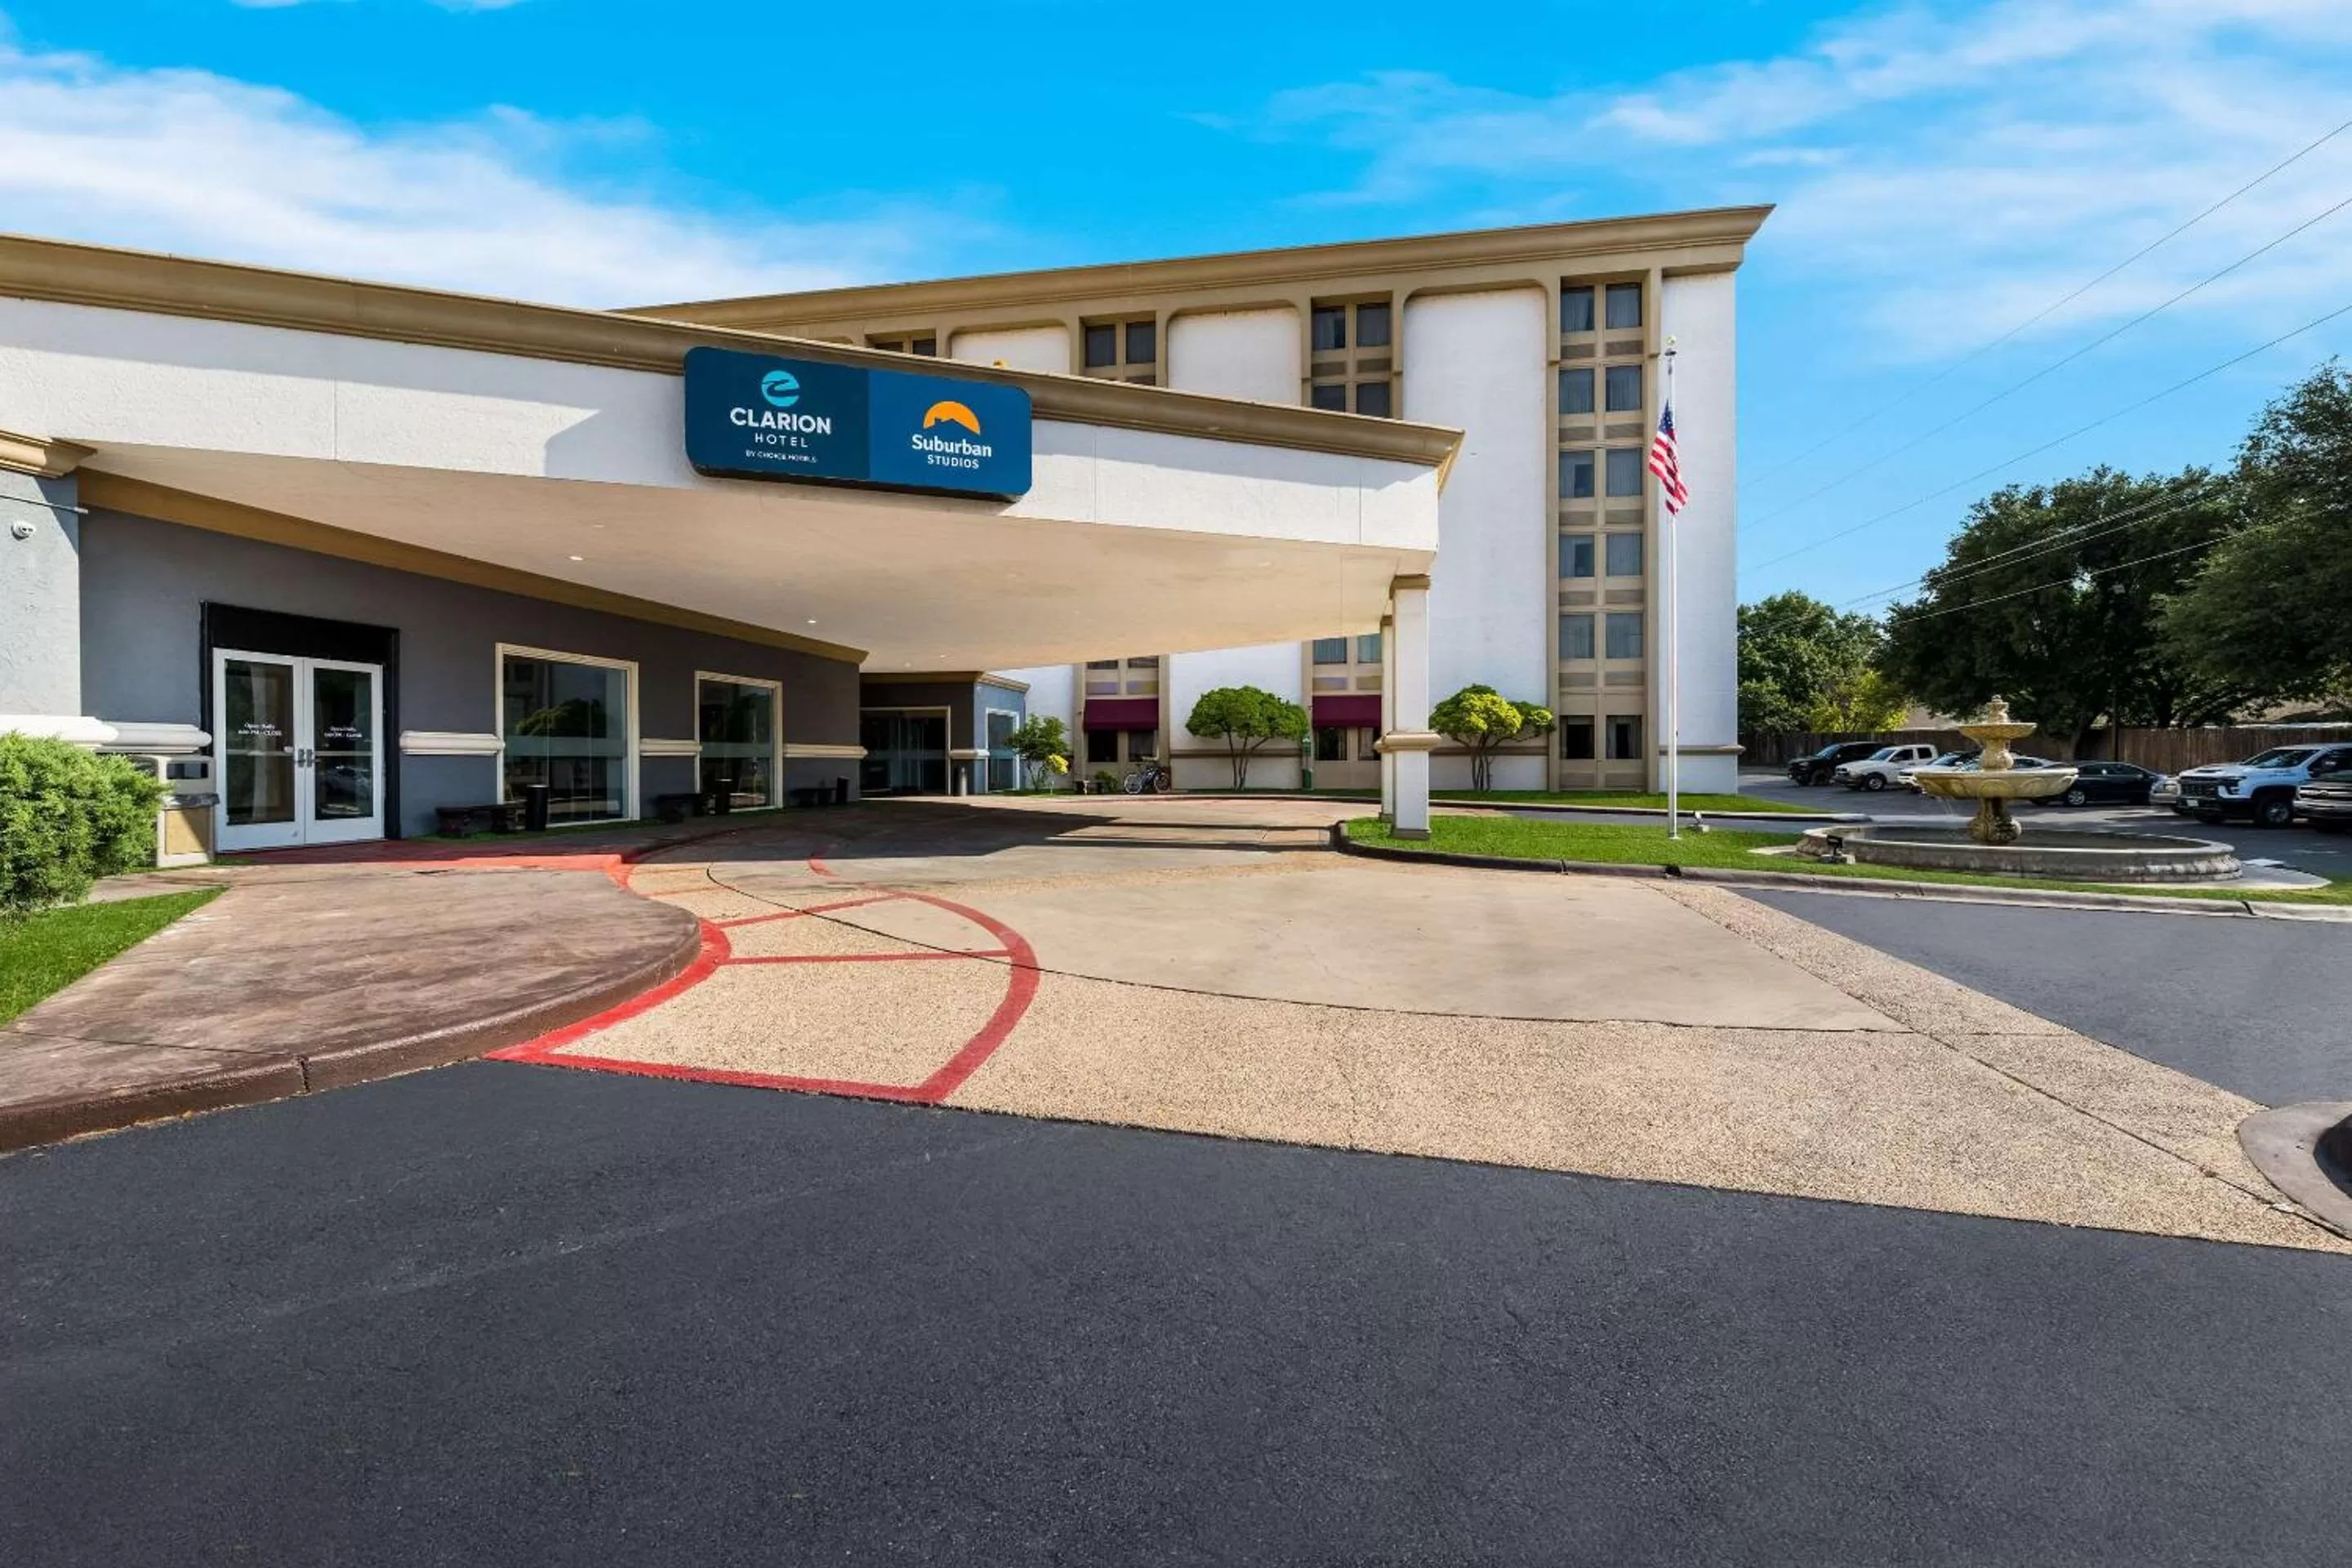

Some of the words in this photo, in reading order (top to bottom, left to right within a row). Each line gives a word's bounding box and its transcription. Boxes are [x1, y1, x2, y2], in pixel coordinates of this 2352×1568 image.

[730, 407, 831, 434] CLARION
[755, 433, 808, 448] HOTEL
[911, 434, 992, 457] Suburban
[746, 449, 756, 457] BY
[757, 451, 786, 460] CHOICE
[787, 454, 817, 463] HOTELS
[927, 454, 980, 470] STUDIOS
